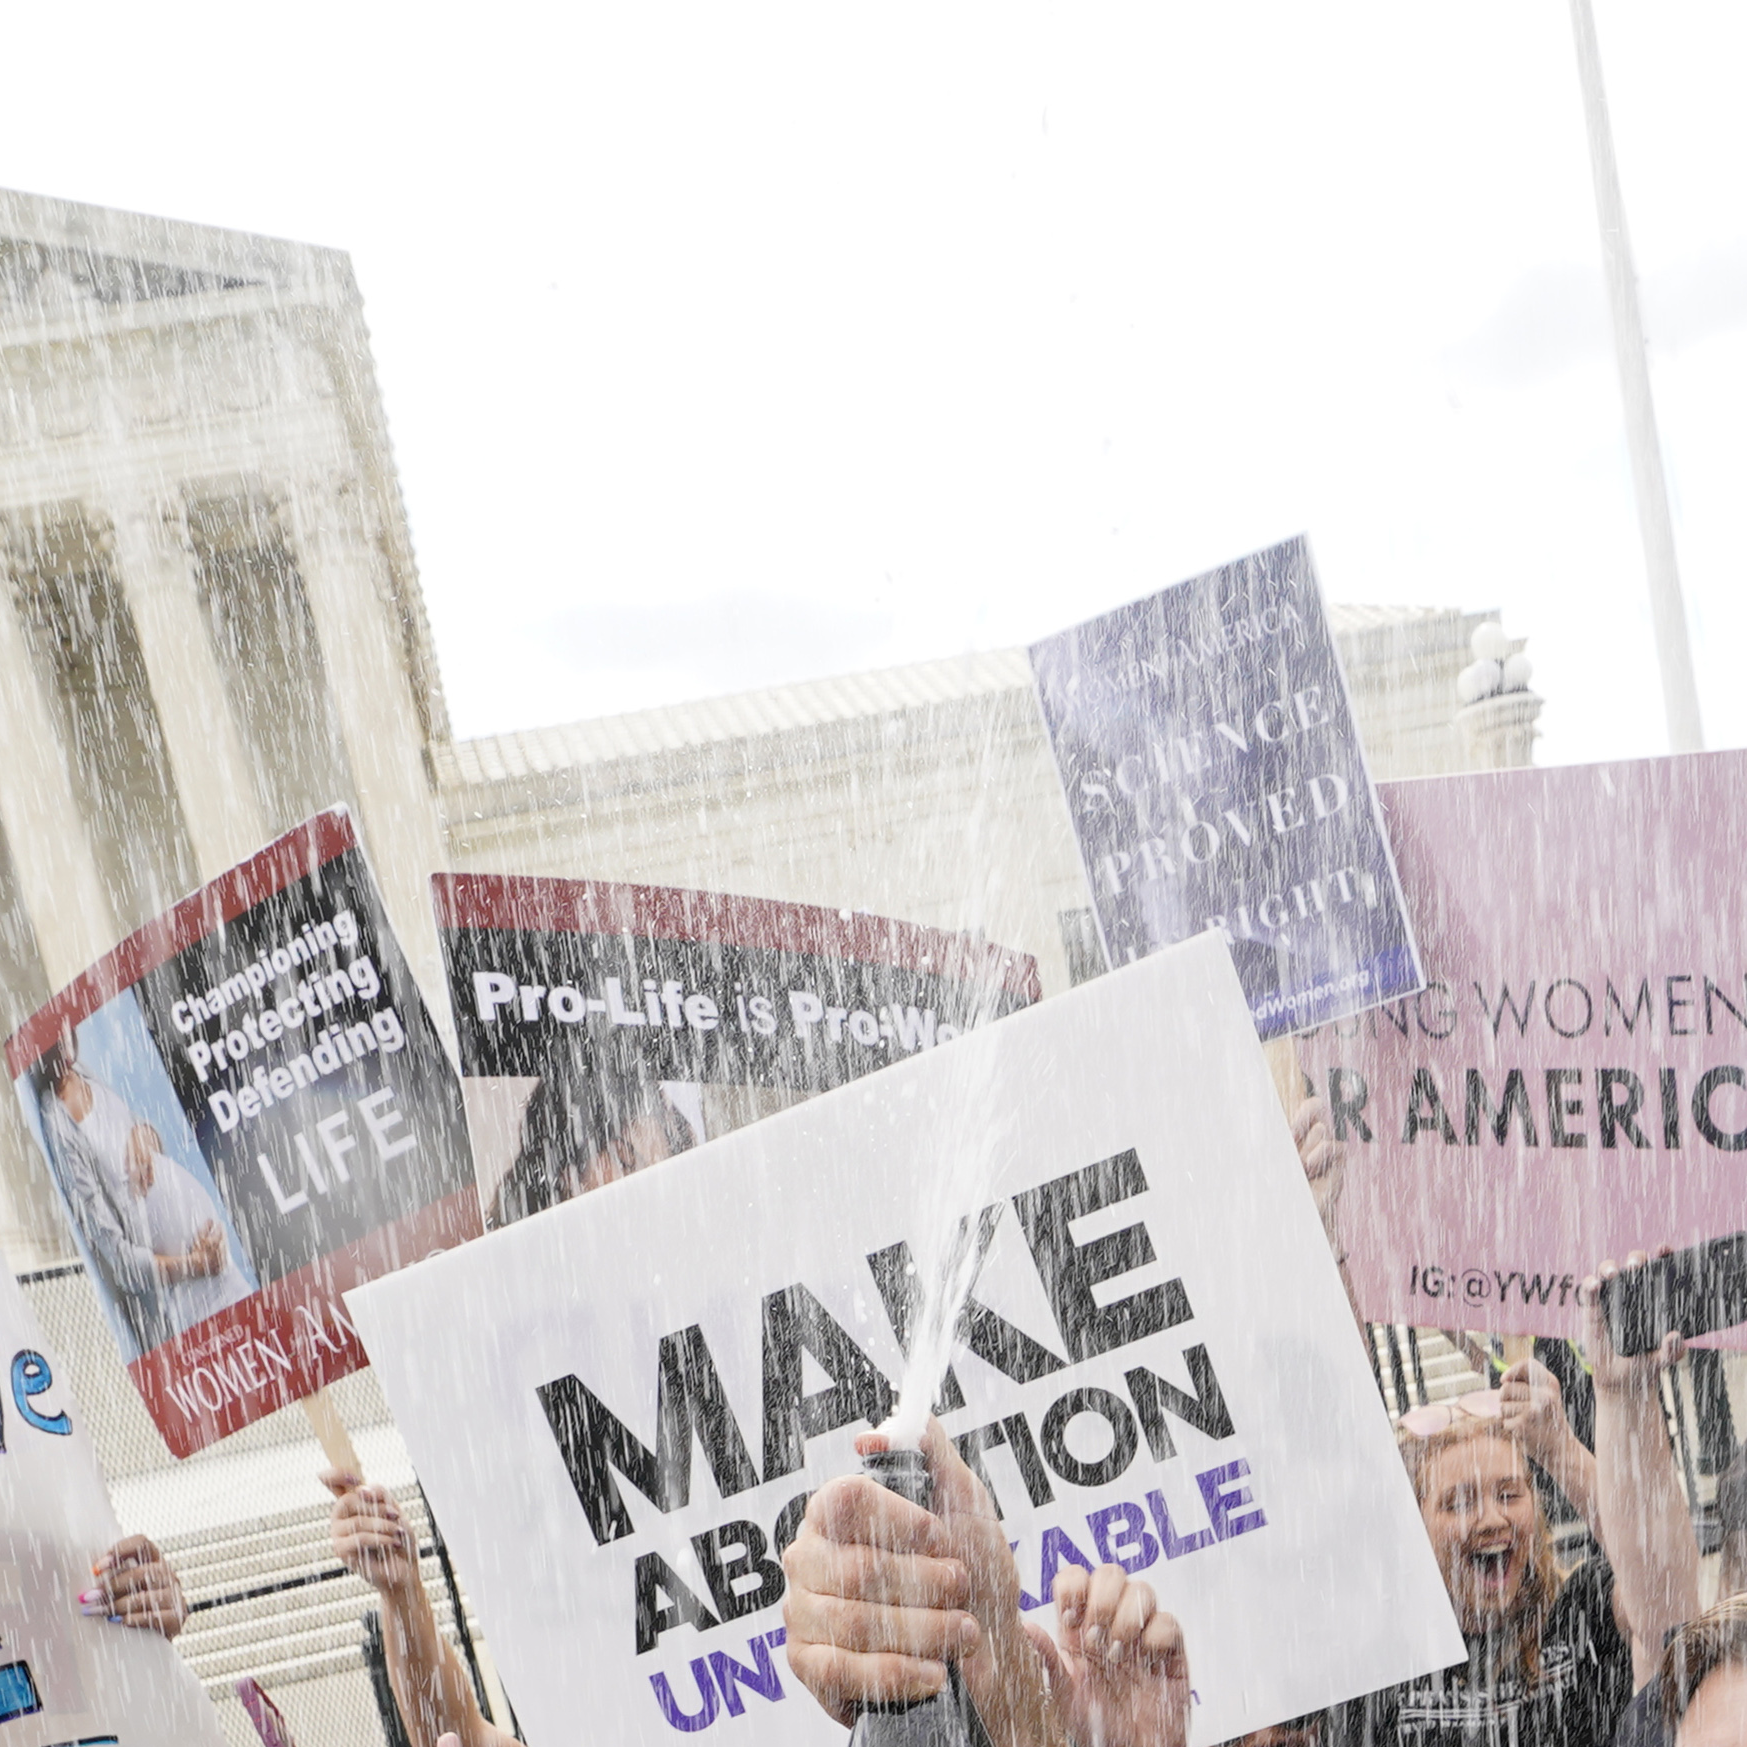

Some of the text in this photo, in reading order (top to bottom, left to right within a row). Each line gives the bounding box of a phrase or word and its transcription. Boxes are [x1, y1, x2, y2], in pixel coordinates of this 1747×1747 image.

[1082, 686, 1330, 812] SCIENCE
[1104, 773, 1349, 895] PROVED
[172, 908, 359, 1034] Championing
[188, 954, 381, 1082] Protecting
[472, 971, 720, 1031] Pro-Life
[735, 991, 777, 1036] is
[207, 1008, 406, 1133] Defending
[256, 1086, 418, 1216] LIFE
[165, 1328, 292, 1423] WOMEN
[535, 1147, 1194, 1547] MAKE
[634, 1342, 1238, 1656] ABTION
